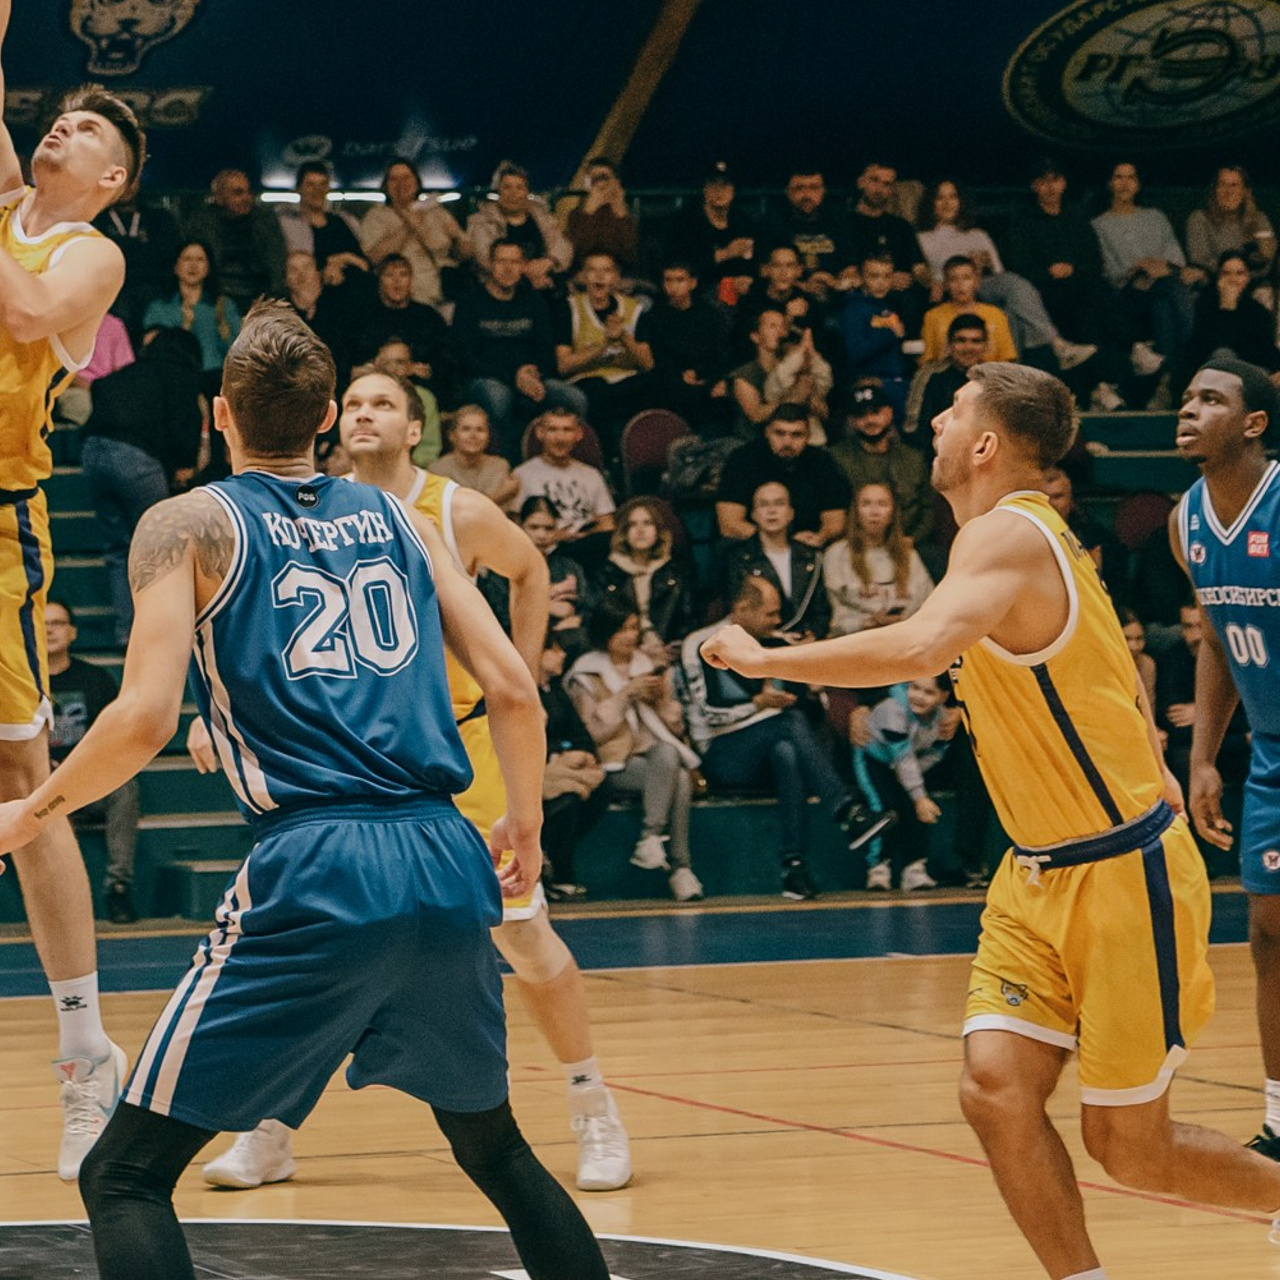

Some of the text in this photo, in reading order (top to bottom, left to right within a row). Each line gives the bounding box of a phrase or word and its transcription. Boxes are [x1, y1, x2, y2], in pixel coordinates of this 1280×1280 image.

[262, 510, 394, 553] КОЧЕРГИН
[271, 555, 420, 680] 20
[1225, 623, 1270, 668] 00
